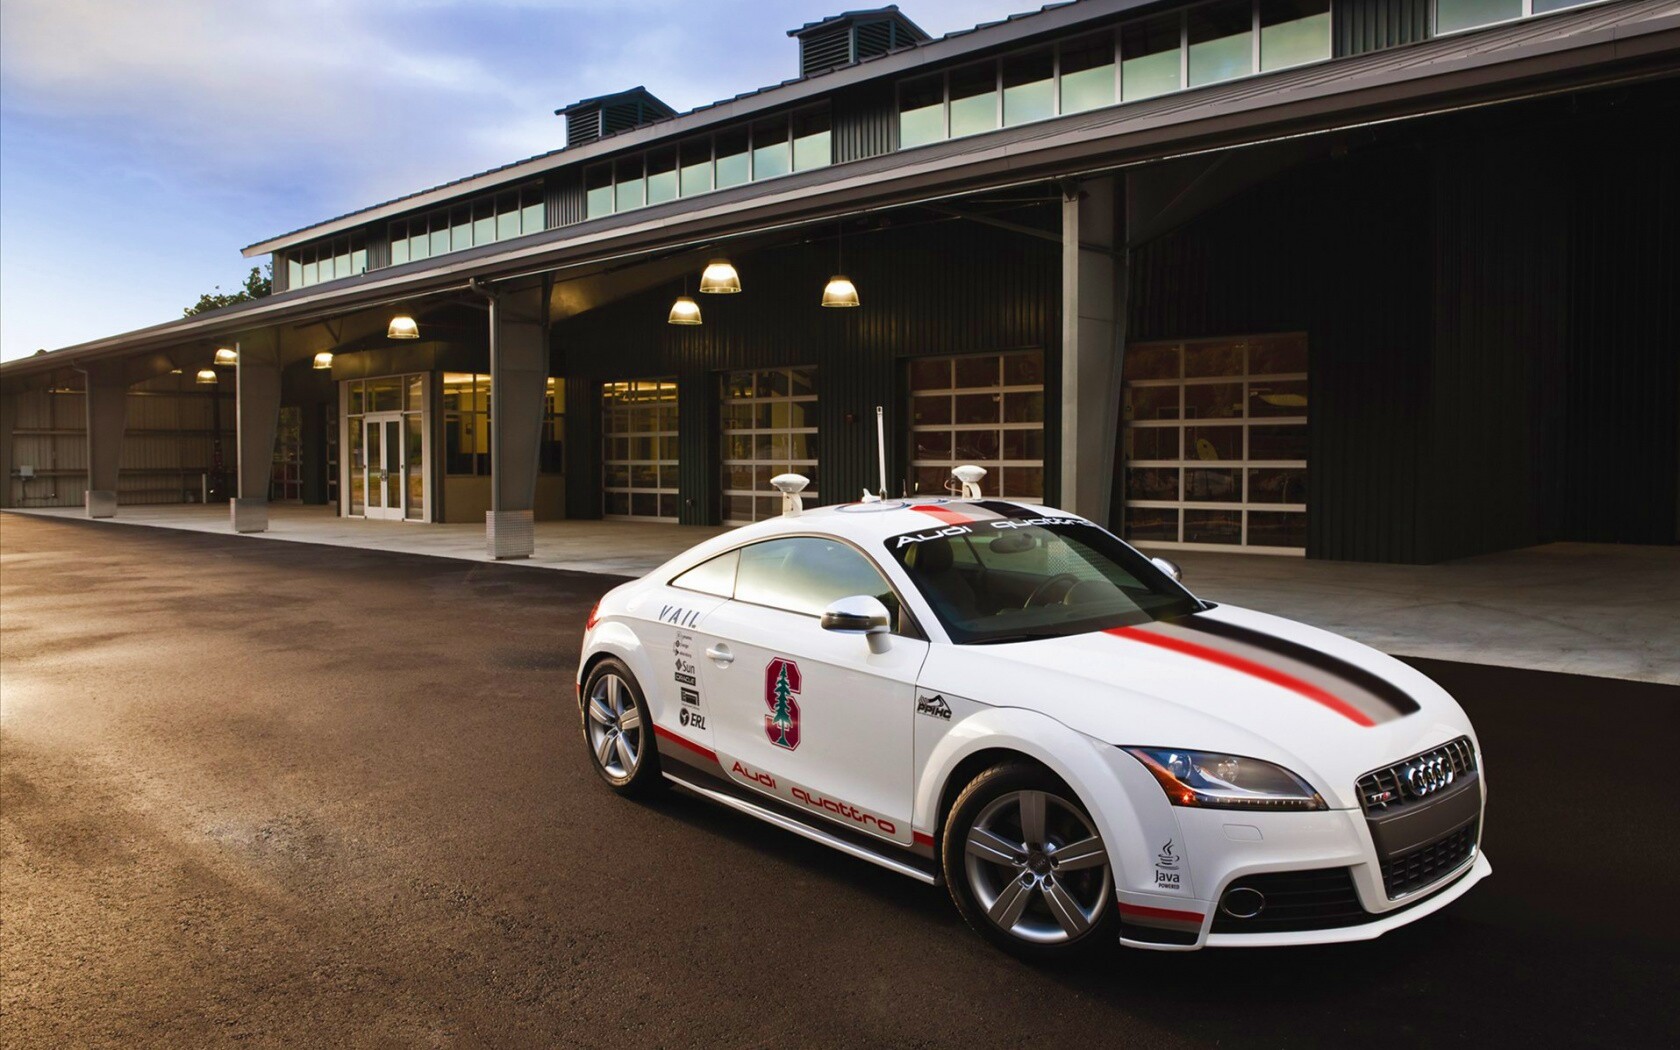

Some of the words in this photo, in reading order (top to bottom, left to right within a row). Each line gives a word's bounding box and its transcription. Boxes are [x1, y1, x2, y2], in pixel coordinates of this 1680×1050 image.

[896, 525, 973, 549] Audi
[658, 604, 700, 628] VAIL
[682, 660, 696, 675] Sun
[917, 702, 952, 719] PPIHC
[690, 713, 706, 730] ERL
[732, 761, 777, 789] Audi
[791, 787, 896, 835] quattro
[1154, 869, 1180, 884] Java
